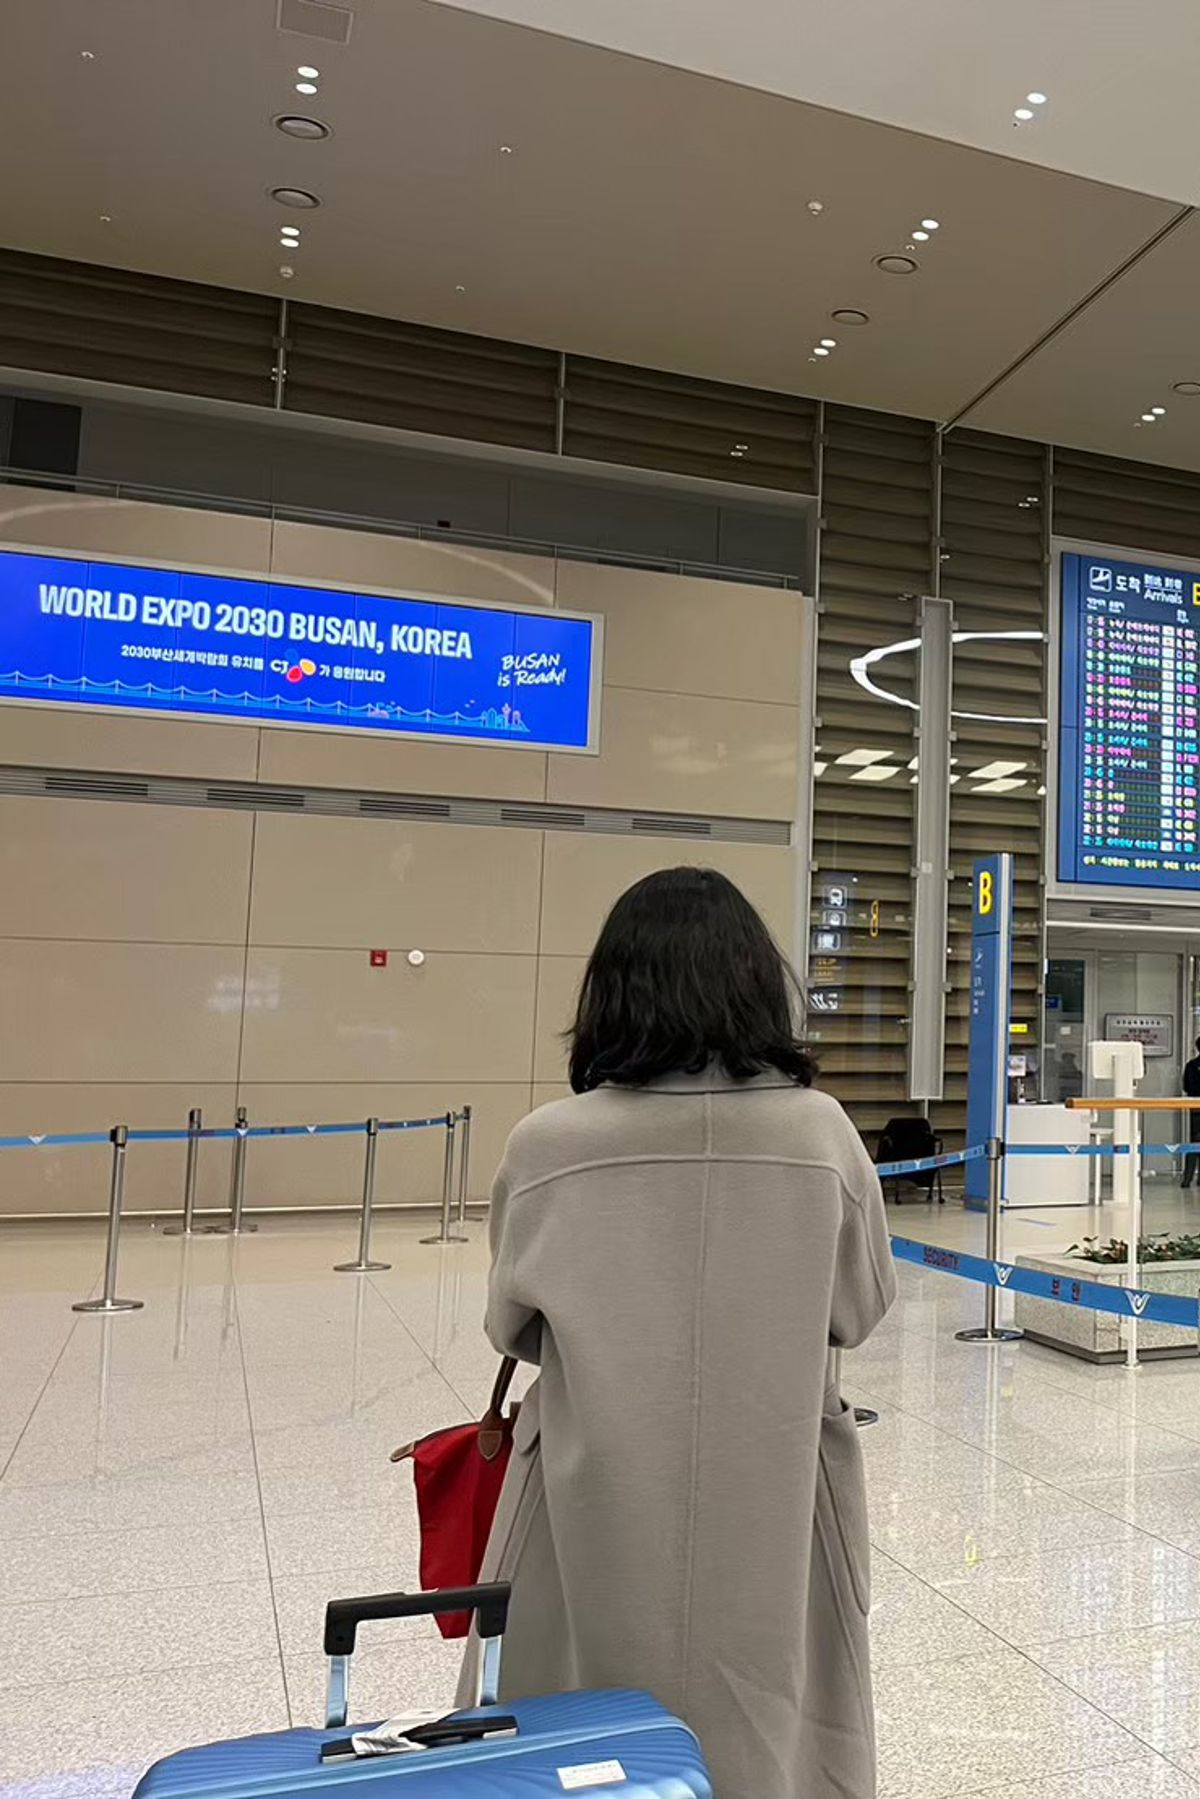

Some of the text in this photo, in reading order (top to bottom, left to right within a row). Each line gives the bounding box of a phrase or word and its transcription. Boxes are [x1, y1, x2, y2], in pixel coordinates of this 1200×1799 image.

[39, 584, 473, 659] WORLD EXPO 2030 BUSAN, KOREA
[270, 660, 288, 674] CJ
[501, 652, 560, 671] BUSAN
[497, 667, 567, 688] is Ready!
[979, 870, 993, 914] B
